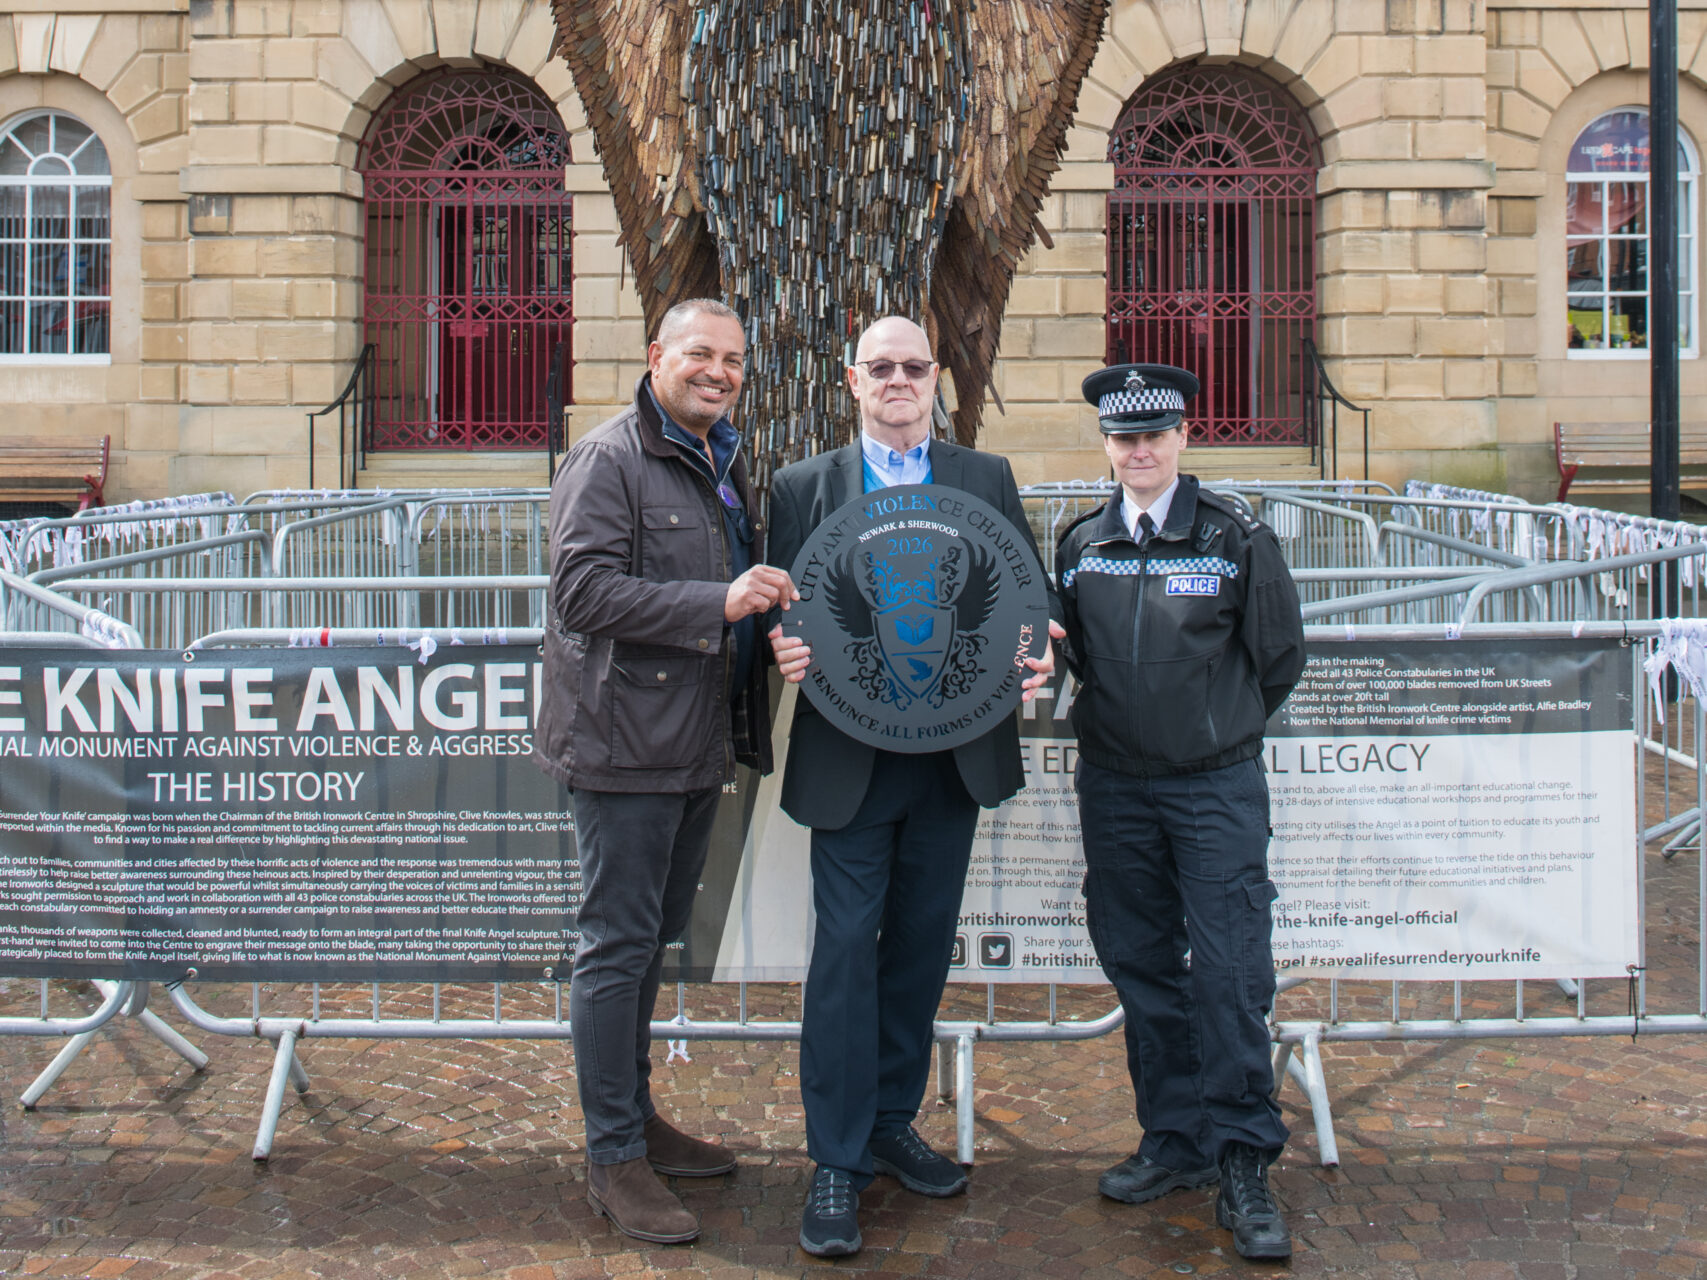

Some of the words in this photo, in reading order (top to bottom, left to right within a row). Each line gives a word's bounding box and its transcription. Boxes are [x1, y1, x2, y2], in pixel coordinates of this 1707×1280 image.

[858, 521, 897, 544] NEWARK
[898, 520, 906, 529] &
[907, 520, 959, 538] SHERWOOD
[800, 552, 824, 602] CITY
[862, 495, 965, 520] VIOLENCE
[967, 509, 1032, 590] CHARTER
[887, 536, 934, 556] 2026
[1171, 578, 1216, 593] POLICE
[1306, 658, 1321, 666] ars
[1321, 657, 1332, 666] in
[1332, 656, 1349, 666] the
[1349, 656, 1385, 668] making
[1301, 668, 1328, 678] olved
[1329, 668, 1340, 678] all
[1341, 668, 1354, 678] 43
[1354, 667, 1383, 677] Police
[1383, 667, 1452, 677] Constabularies
[1453, 667, 1463, 676] in
[1464, 667, 1480, 676] the
[1481, 667, 1496, 676] UK
[1310, 679, 1334, 690] from
[1335, 680, 1345, 690] of
[1346, 682, 1366, 690] over
[1369, 680, 1405, 690] 100,000
[1406, 679, 1436, 689] blades
[1438, 678, 1480, 689] removed
[1480, 678, 1504, 688] from
[1505, 678, 1519, 688] UK
[1520, 678, 1552, 688] Streets
[44, 667, 278, 733] KNIFE
[1288, 692, 1320, 702] Stands
[1321, 693, 1331, 702] at
[1332, 694, 1353, 702] over
[1354, 691, 1373, 701] 20ft
[1374, 692, 1389, 701] tall
[1289, 704, 1324, 714] Created
[1326, 704, 1338, 716] by
[1339, 704, 1355, 713] the
[1356, 703, 1386, 713] British
[1388, 703, 1428, 713] Ironwork
[1429, 702, 1460, 712] Centre
[1462, 702, 1507, 714] alongside
[1508, 702, 1535, 712] artist,
[1536, 700, 1557, 710] Alfie
[1558, 699, 1592, 711] Bradley
[880, 723, 913, 740] ALL
[917, 713, 973, 740] FORMS
[974, 698, 994, 719] OF
[1290, 716, 1310, 726] Now
[1311, 716, 1328, 725] the
[1329, 715, 1368, 726] National
[1369, 715, 1414, 726] Memorial
[1415, 715, 1425, 725] of
[1426, 714, 1449, 724] knife
[1450, 714, 1476, 724] crime
[1478, 714, 1512, 724] victims
[38, 737, 178, 758] MONUMENT
[184, 736, 285, 757] AGAINST
[288, 735, 400, 756] VIOLENCE
[406, 735, 423, 756] &
[428, 734, 533, 756] AGGRESS
[1300, 743, 1431, 774] LEGACY
[147, 772, 212, 802] THE
[223, 772, 365, 802] HISTORY
[39, 811, 61, 821] Your
[61, 811, 87, 820] Knife'
[87, 812, 132, 823] campaign
[151, 812, 174, 821] born
[174, 812, 201, 821] when
[202, 811, 218, 821] the
[219, 811, 264, 821] Chairman
[264, 811, 276, 820] of
[276, 811, 292, 820] the
[293, 811, 322, 821] British
[323, 811, 363, 821] Ironwork
[364, 811, 395, 820] Centre
[396, 811, 406, 820] in
[407, 810, 458, 822] Shropshire,
[458, 810, 482, 820] Clive
[482, 810, 523, 820] Knowles,
[524, 812, 542, 820] was
[543, 810, 572, 820] struck
[93, 835, 104, 844] to
[105, 834, 123, 844] find
[131, 837, 150, 846] way
[151, 835, 162, 844] to
[163, 835, 188, 844] make
[196, 834, 214, 844] real
[215, 834, 261, 844] difference
[262, 834, 274, 846] by
[275, 834, 330, 846] highlighting
[331, 834, 349, 844] this
[350, 834, 403, 846] devastating
[404, 834, 442, 843] national
[443, 834, 468, 843] issue.
[1322, 831, 1354, 842] affects
[1373, 832, 1394, 841] lives
[1395, 831, 1423, 840] within
[1424, 832, 1450, 841] every
[1451, 830, 1505, 840] community.
[10, 890, 42, 902] sought
[43, 891, 92, 903] permission
[92, 893, 102, 901] to
[103, 893, 145, 904] approach
[146, 893, 165, 903] and
[166, 893, 190, 902] work
[191, 893, 200, 902] in
[201, 892, 261, 902] collaboration
[262, 892, 283, 902] with
[284, 892, 296, 902] all
[296, 893, 309, 902] 43
[310, 892, 338, 904] police
[338, 892, 404, 902] constabularies
[405, 894, 433, 902] across
[434, 893, 450, 902] the
[451, 892, 468, 902] UK.
[468, 892, 486, 902] The
[487, 893, 532, 902] Ironworks
[532, 893, 566, 903] offered
[567, 894, 578, 902] to
[1040, 899, 1071, 910] Want
[1074, 901, 1087, 911] to
[1271, 900, 1302, 914] ngel?
[1305, 900, 1342, 911] Please
[1344, 899, 1371, 910] visit:
[1024, 936, 1056, 947] Share
[1058, 938, 1084, 949] your
[1292, 937, 1344, 950] hashtags:
[1309, 948, 1542, 967] #savealifesurrenderyourknife
